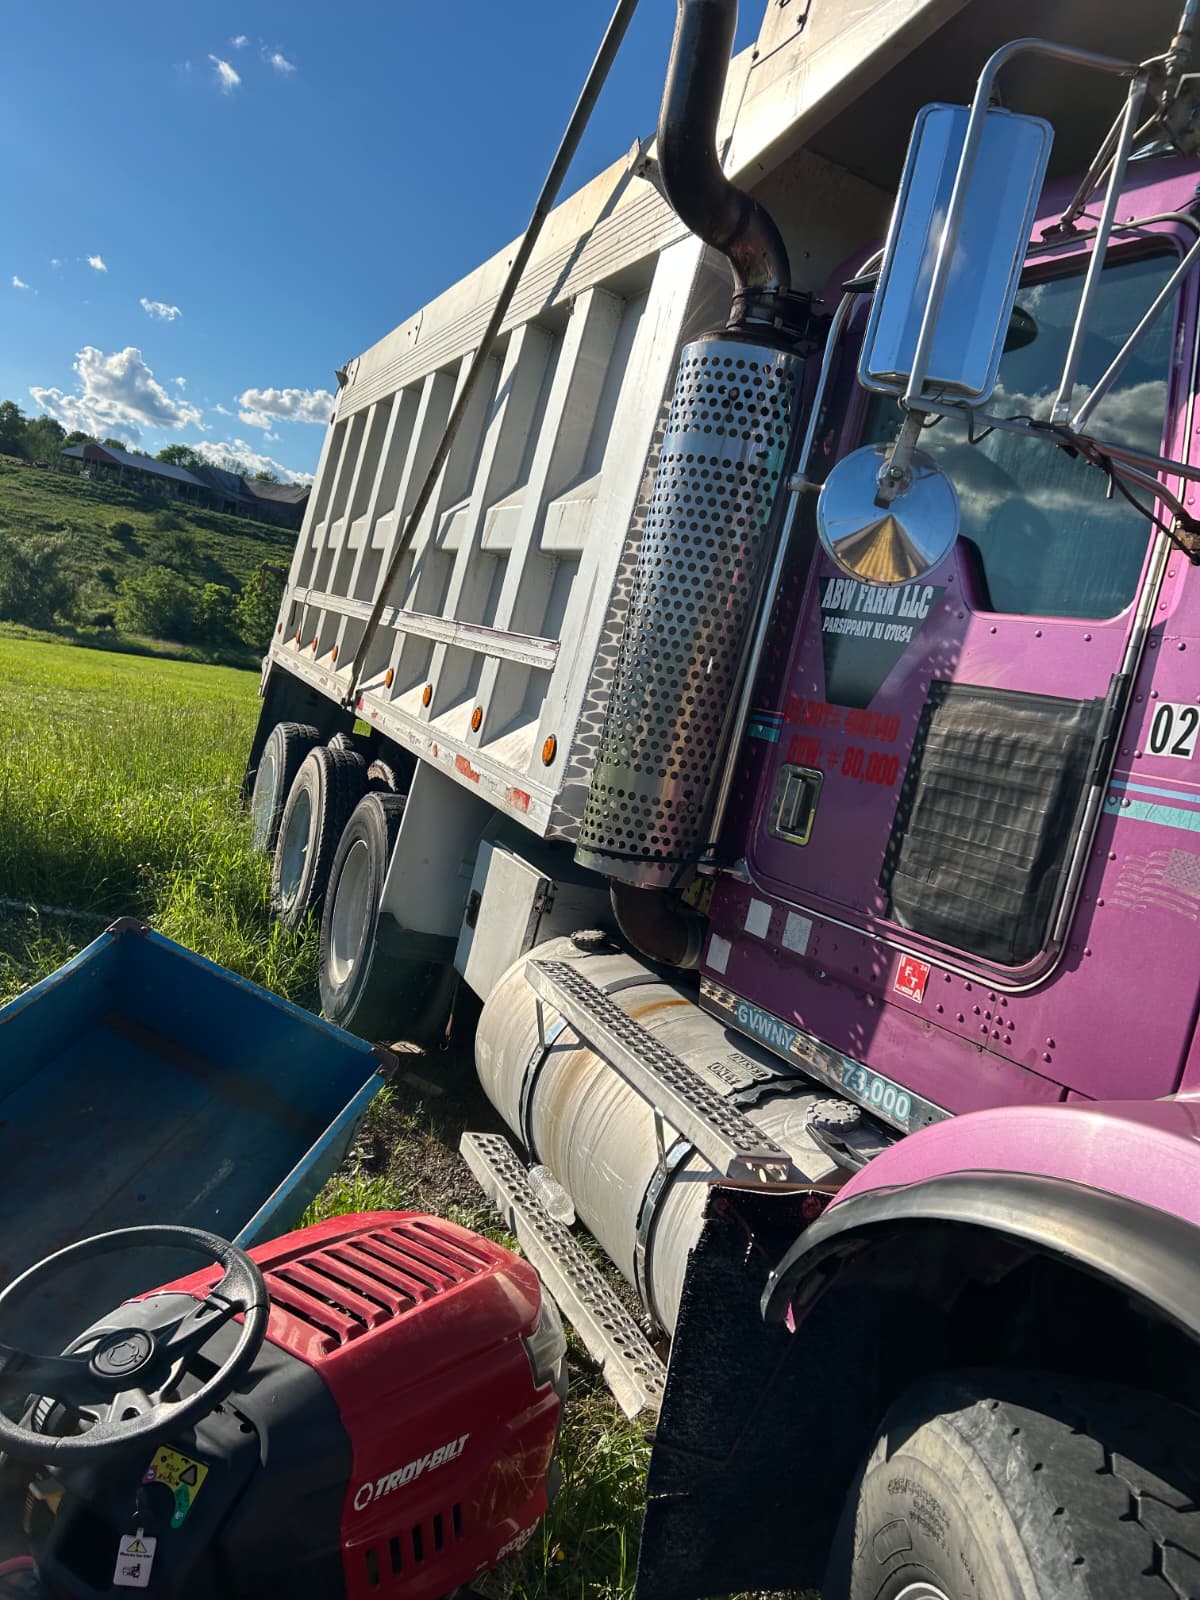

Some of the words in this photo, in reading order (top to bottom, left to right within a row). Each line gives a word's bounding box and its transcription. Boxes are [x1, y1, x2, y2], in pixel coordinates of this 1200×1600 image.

[821, 578, 858, 611] ABW
[855, 583, 900, 615] FARM
[898, 584, 934, 619] LLC
[822, 616, 874, 638] PARSIPPANY
[872, 621, 885, 639] NJ
[884, 624, 914, 643] 07034
[1150, 703, 1200, 757] 02
[841, 745, 900, 787] 80,000
[841, 1058, 910, 1119] 73,000
[374, 1433, 470, 1501] TROY-BILT
